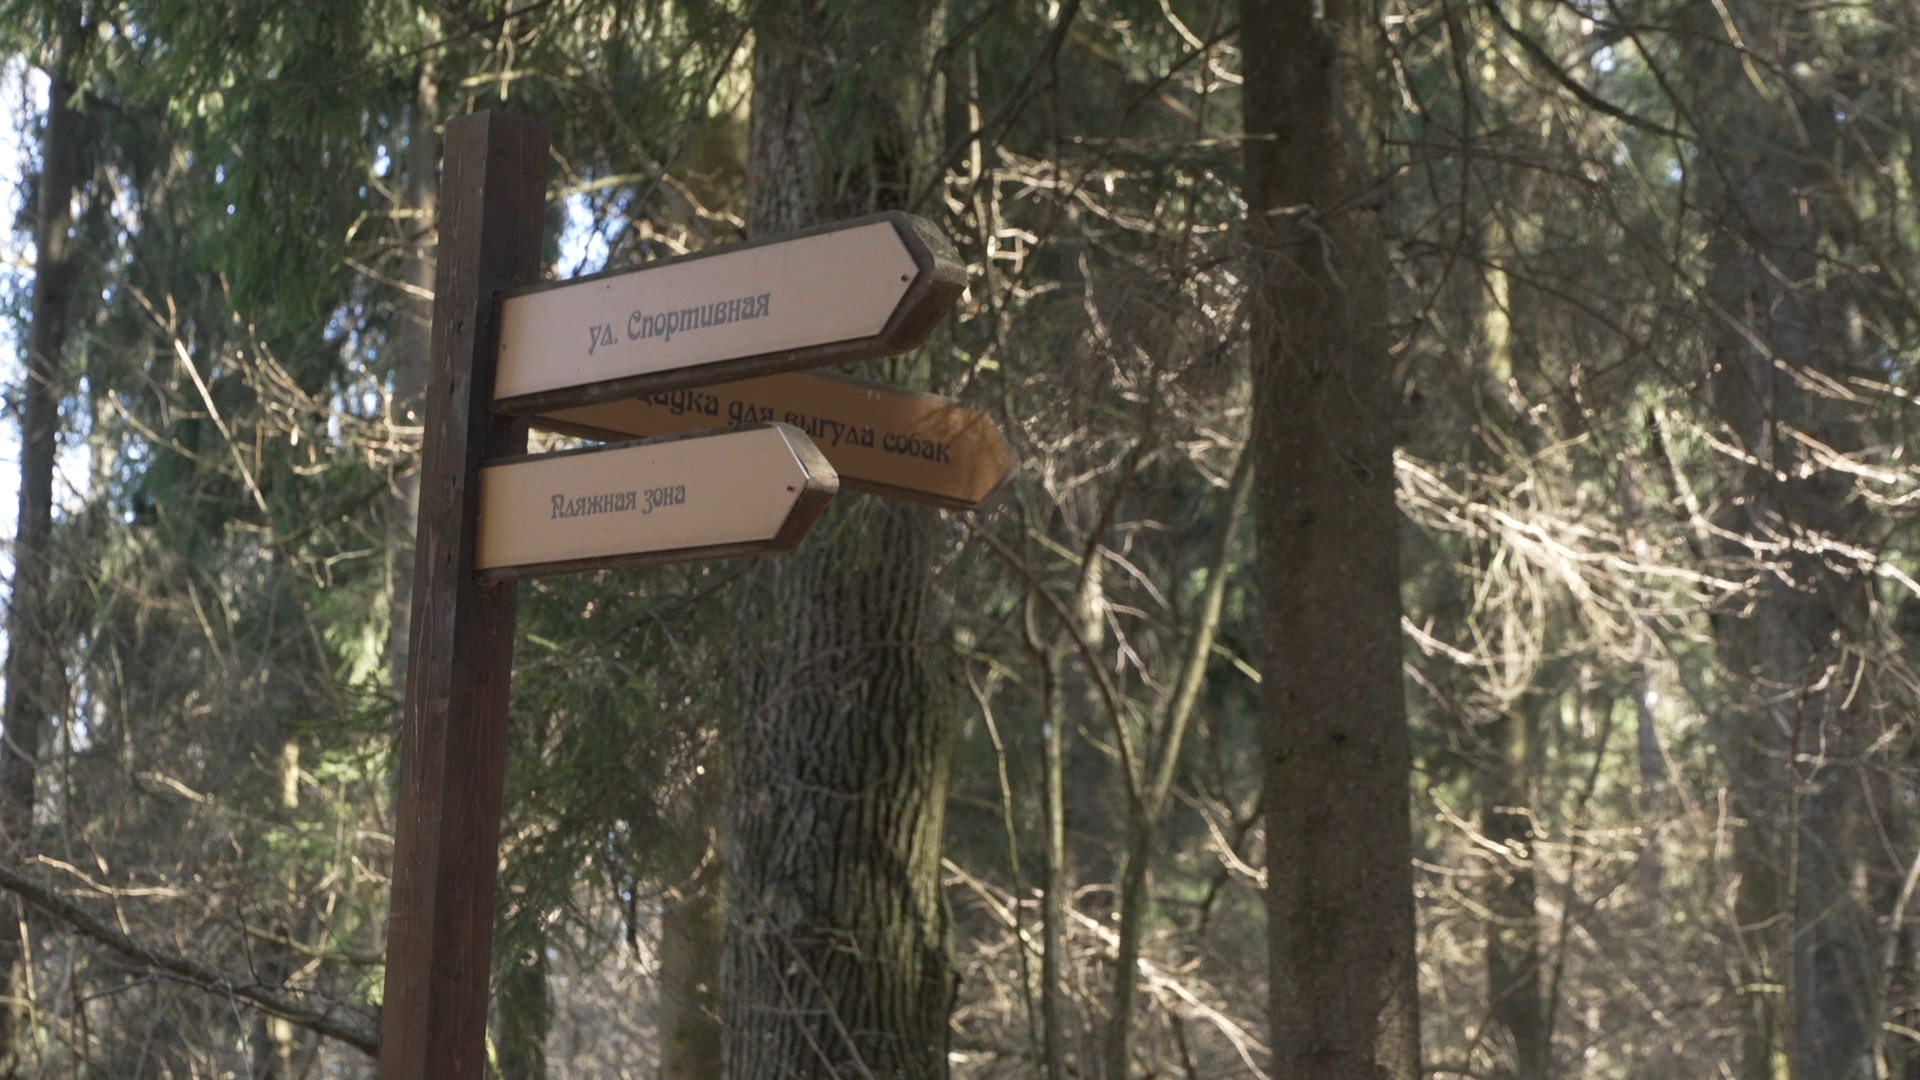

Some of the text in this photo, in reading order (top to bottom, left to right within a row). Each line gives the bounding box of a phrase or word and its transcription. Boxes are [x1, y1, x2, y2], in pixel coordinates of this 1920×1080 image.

[588, 293, 771, 356] ул. Спортивная
[642, 390, 950, 463] адка для выгула собак
[550, 484, 686, 520] Пляжная зона
